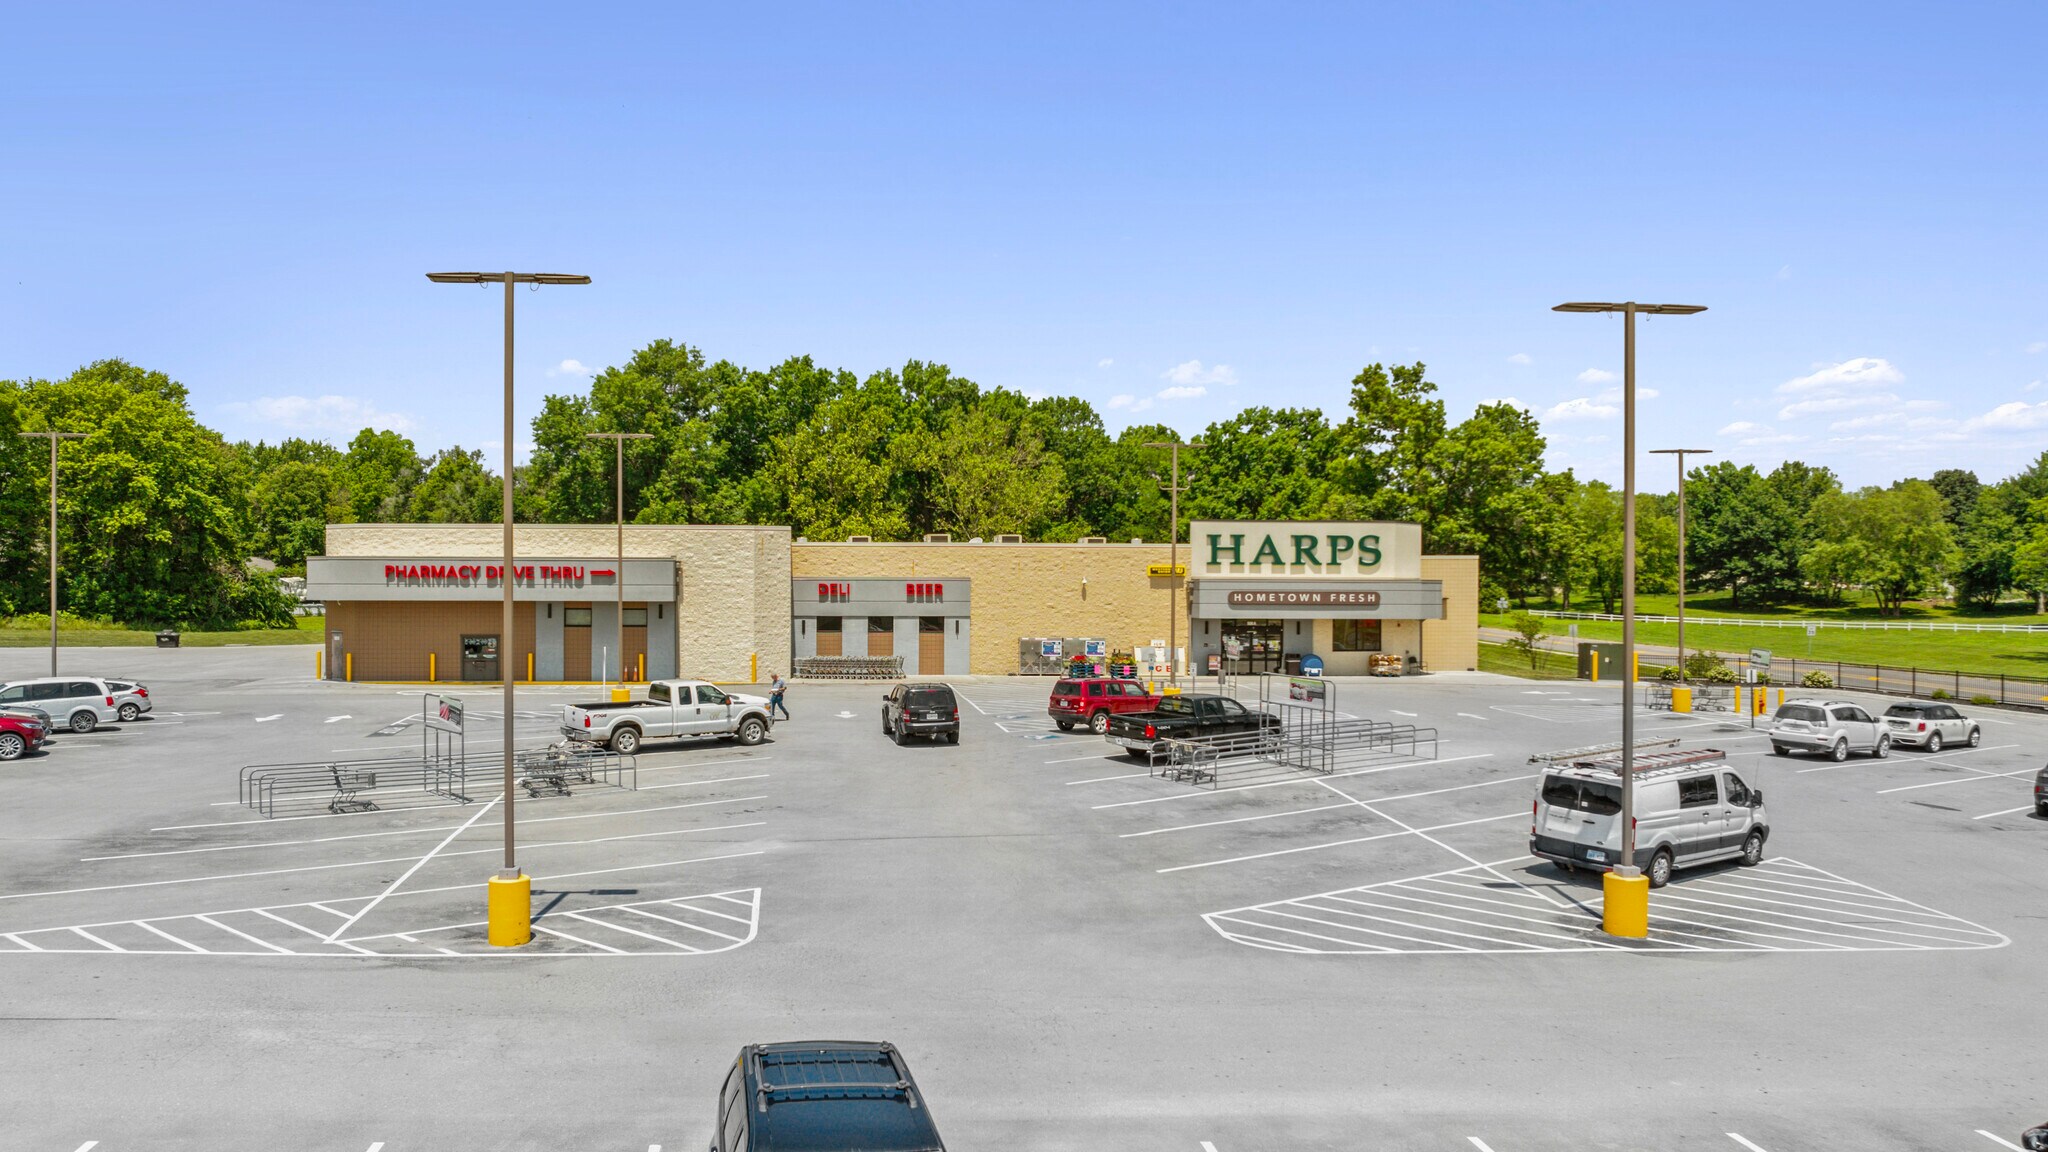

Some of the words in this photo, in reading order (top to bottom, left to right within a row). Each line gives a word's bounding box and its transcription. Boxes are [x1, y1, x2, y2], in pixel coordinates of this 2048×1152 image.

[1206, 534, 1382, 566] HARPS
[385, 565, 481, 579] PHARMACY
[486, 565, 535, 580] DVE
[540, 566, 585, 580] THRU
[818, 583, 850, 596] DELI
[906, 583, 943, 596] BEER
[1234, 593, 1321, 603] HOMETOWN
[1330, 593, 1376, 603] FRESH
[1149, 665, 1172, 673] CE
